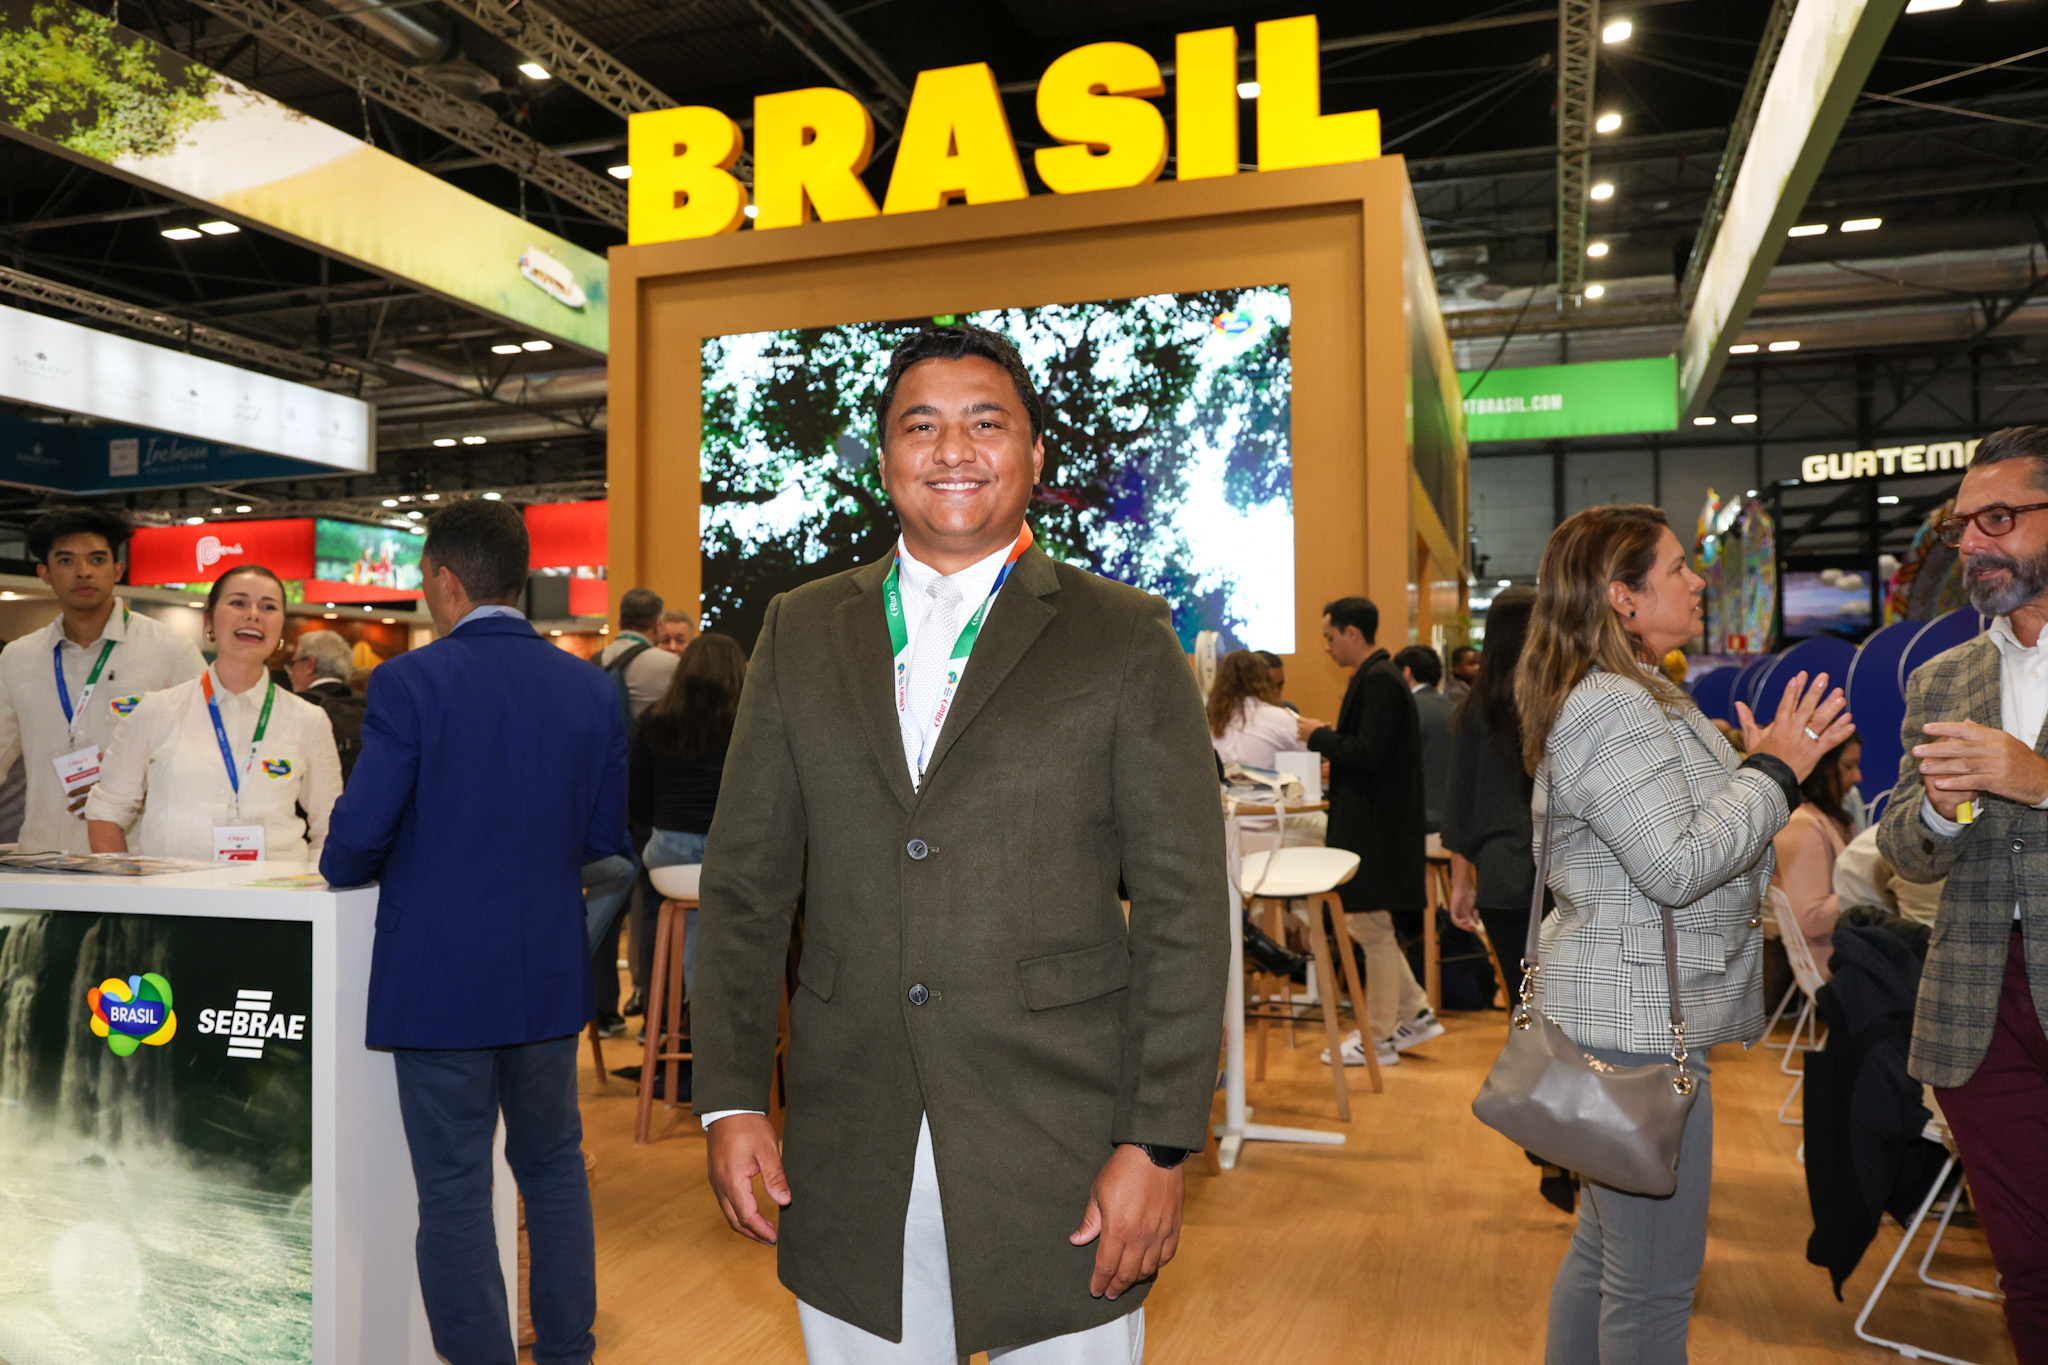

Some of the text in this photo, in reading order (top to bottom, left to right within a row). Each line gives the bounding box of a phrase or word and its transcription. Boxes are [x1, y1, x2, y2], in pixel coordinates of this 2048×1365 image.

[628, 14, 1381, 245] BRASIL
[110, 1006, 158, 1025] BRASIL
[197, 1008, 306, 1040] SEBRAE
